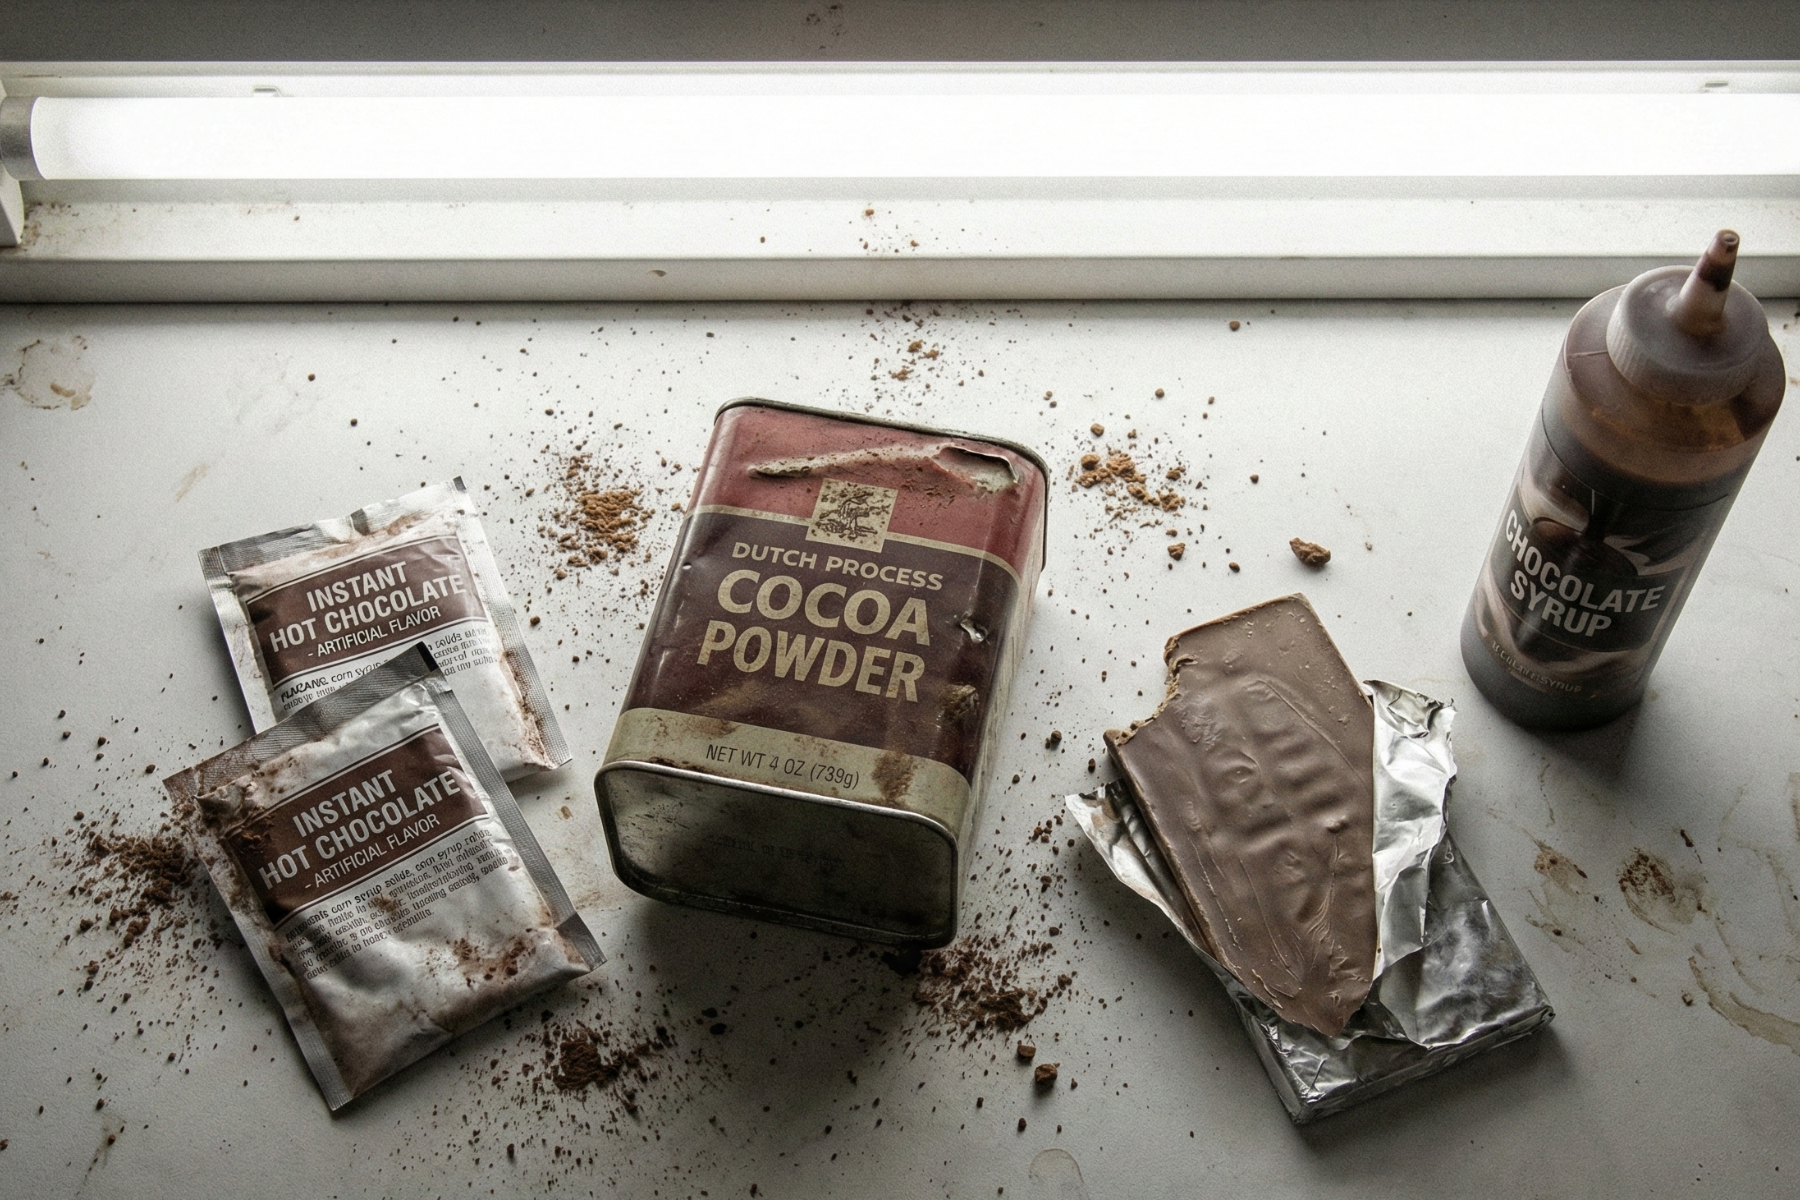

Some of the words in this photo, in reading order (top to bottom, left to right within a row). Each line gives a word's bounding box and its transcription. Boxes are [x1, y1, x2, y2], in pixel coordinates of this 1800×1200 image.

[306, 561, 407, 612] INSTANT
[732, 542, 817, 569] DUTCH
[825, 555, 943, 591] PROCESS
[1506, 509, 1666, 613] CHOCOLATE
[269, 618, 317, 652] HOT
[324, 575, 466, 633] CHOCOLATE
[317, 625, 388, 657] ARTIFICIAL
[389, 605, 441, 634] FLAVOR
[717, 569, 930, 646] COCOA
[1510, 570, 1612, 637] SYRUP
[331, 671, 353, 682] corn
[697, 620, 925, 703] POWDER
[706, 744, 738, 763] NET
[741, 750, 766, 768] WT
[769, 756, 780, 771] 4
[784, 758, 806, 776] OZ
[810, 763, 859, 790] (739g)
[258, 845, 311, 890] HOT
[315, 771, 461, 860] CHOCOLATE
[293, 769, 396, 838] INSTANT
[314, 842, 387, 888] ARTIFICIAL
[386, 813, 440, 850] FLAVOR
